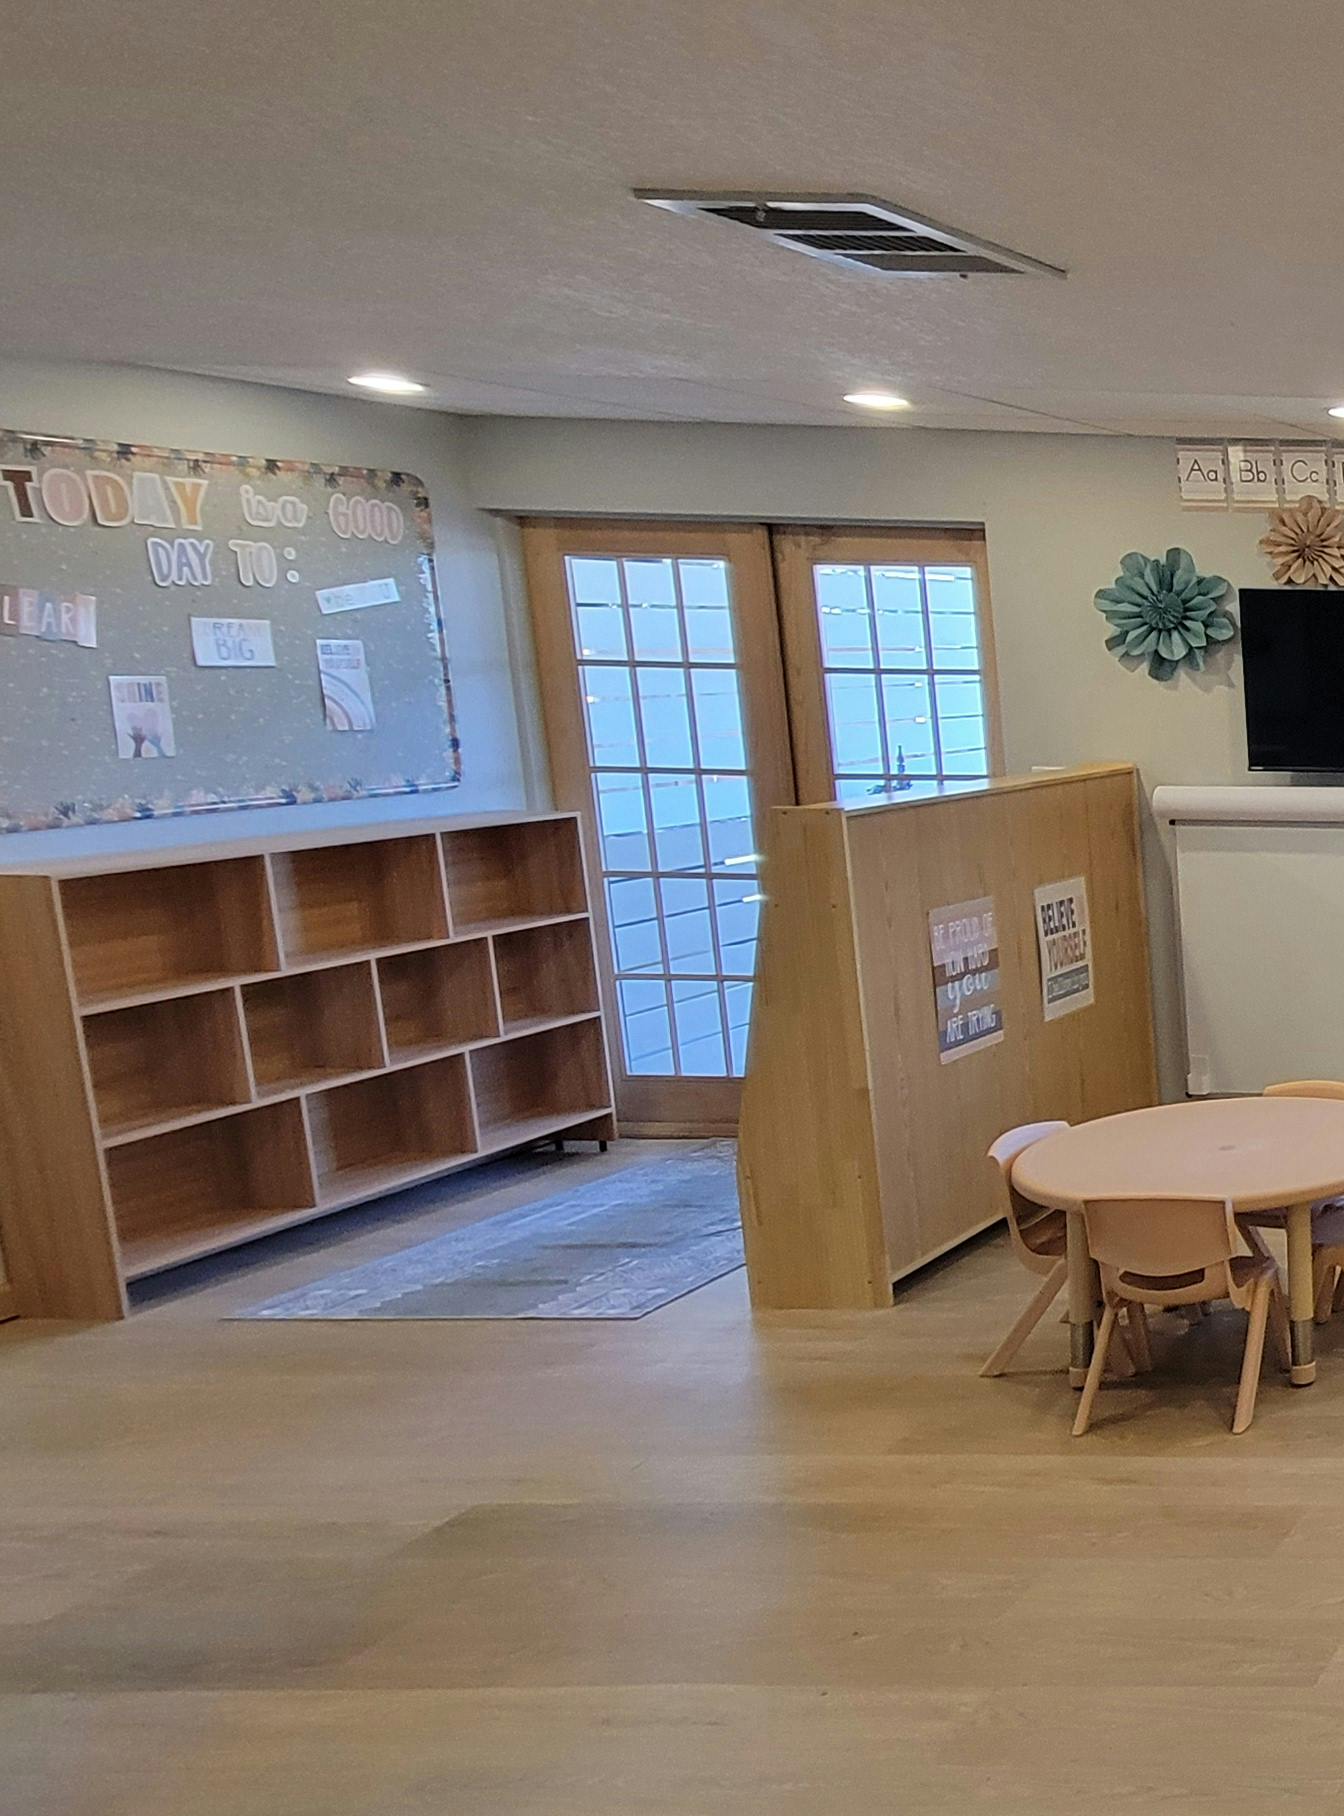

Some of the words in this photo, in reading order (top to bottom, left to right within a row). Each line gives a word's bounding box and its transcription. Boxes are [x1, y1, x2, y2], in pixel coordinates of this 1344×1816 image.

[1185, 458, 1218, 482] Aa
[1238, 459, 1267, 483] Bb
[1290, 459, 1319, 483] Cc
[0, 466, 208, 530] TODAY
[240, 485, 277, 527] is
[278, 496, 308, 527] a
[329, 493, 403, 544] GOOD
[147, 537, 214, 587] DAY
[215, 638, 255, 661] BIG
[1040, 897, 1077, 938] BELIEVE
[947, 972, 990, 1013] you
[946, 1015, 964, 1043] ARE
[967, 1004, 997, 1036] TRYING
